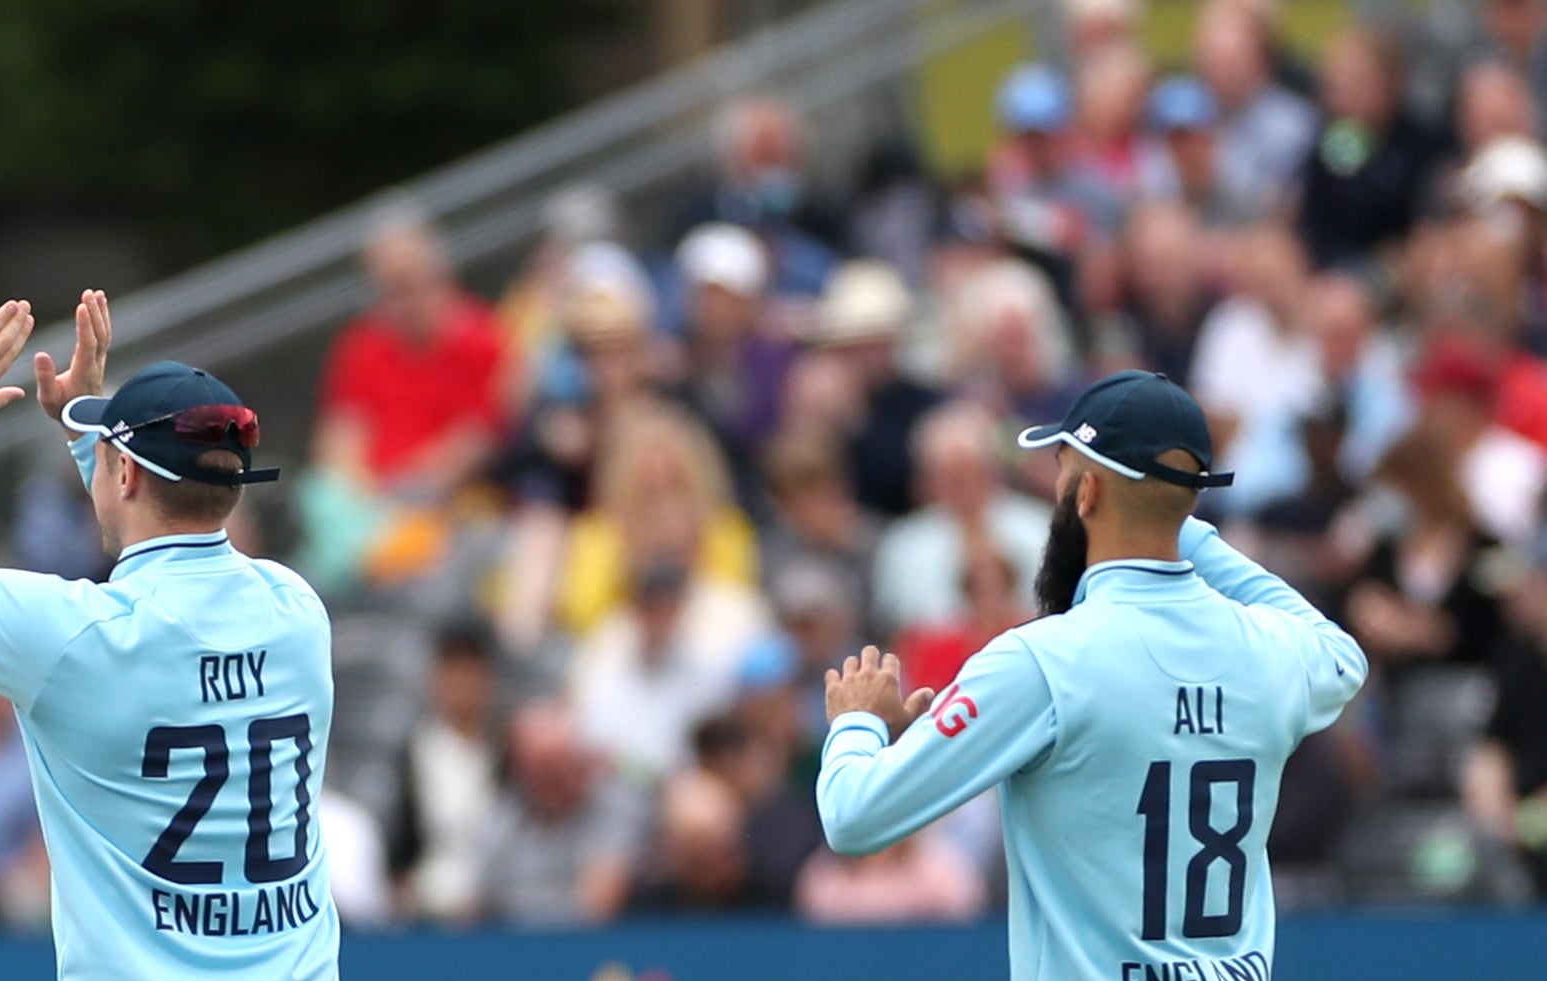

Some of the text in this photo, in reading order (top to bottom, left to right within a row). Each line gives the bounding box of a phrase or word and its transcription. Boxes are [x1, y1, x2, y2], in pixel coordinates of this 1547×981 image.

[200, 649, 267, 702] ROY
[931, 683, 979, 738] IG
[1173, 685, 1225, 735] ALI
[141, 712, 313, 885] 20
[1136, 758, 1257, 941] 18
[151, 879, 320, 937] ENGLAND
